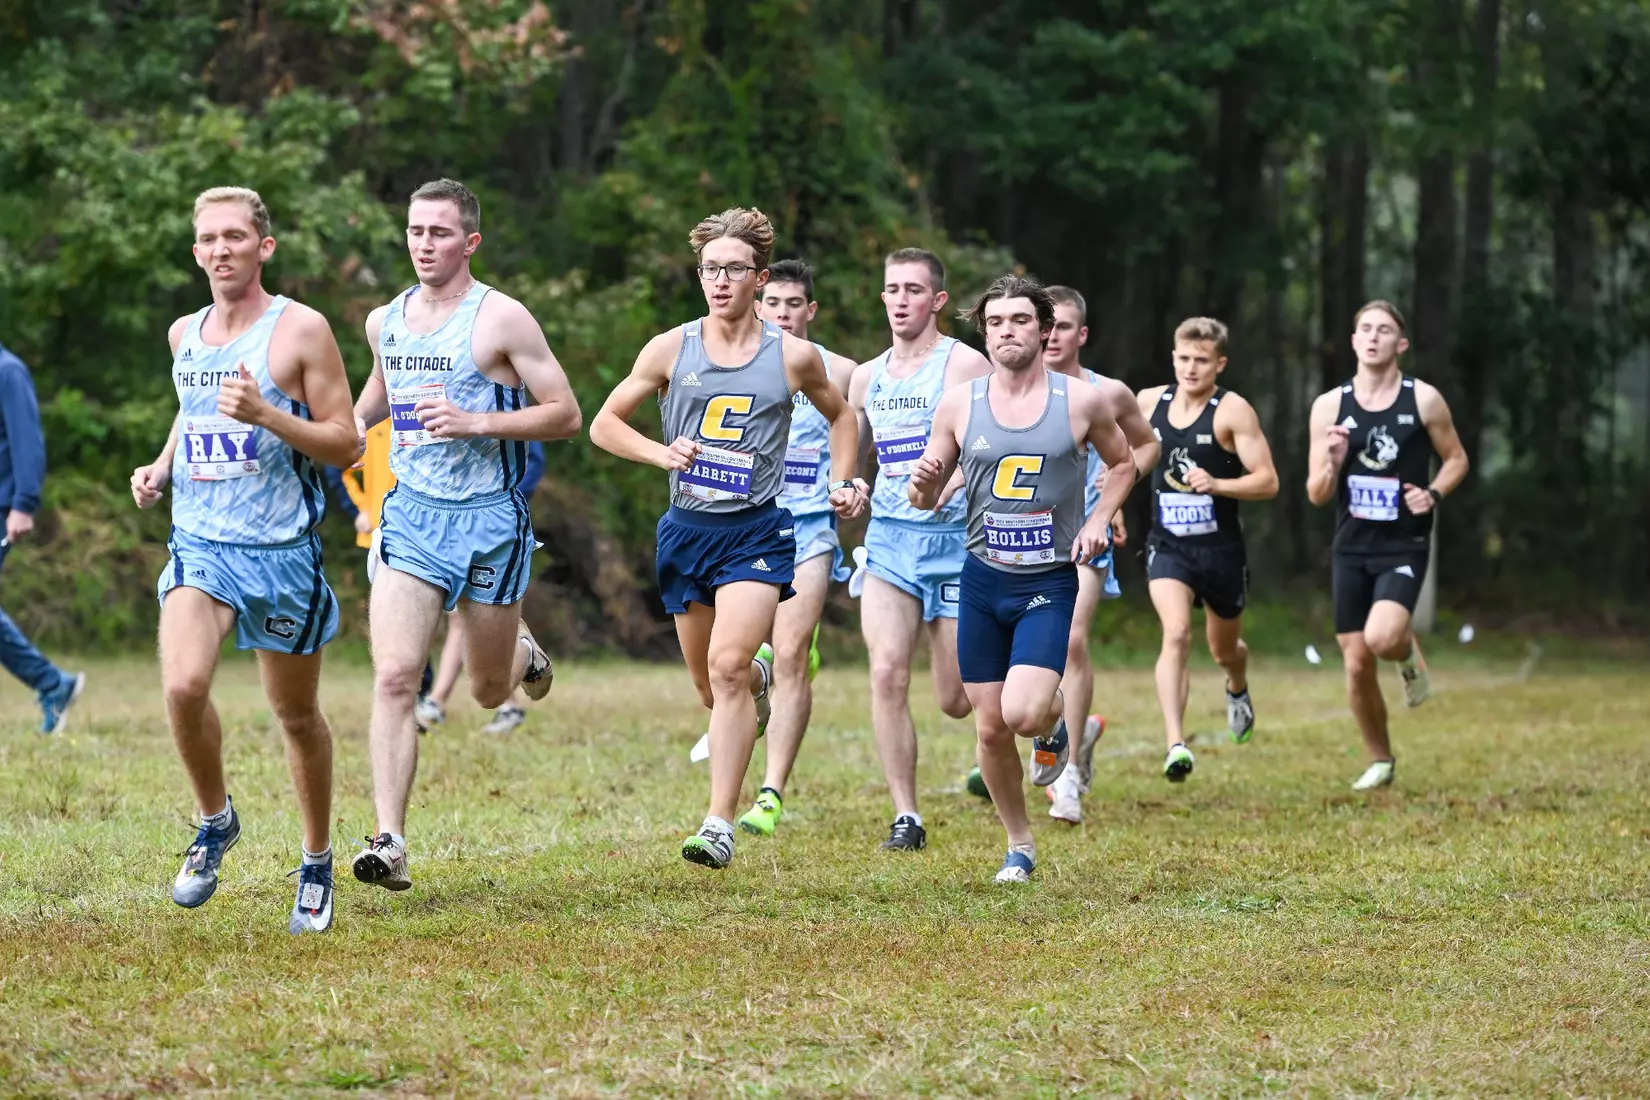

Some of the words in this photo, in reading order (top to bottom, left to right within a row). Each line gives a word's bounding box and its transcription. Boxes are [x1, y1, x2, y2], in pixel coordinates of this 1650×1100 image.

[385, 356, 402, 371] THE
[406, 356, 453, 371] CITADEL
[178, 372, 196, 387] THE
[889, 397, 928, 410] CITADEL
[697, 393, 756, 443] C
[189, 432, 249, 463] RAY
[991, 453, 1046, 502] C
[1351, 489, 1398, 506] DALY
[1161, 505, 1212, 524] MOON
[987, 529, 1051, 546] HOLLIS
